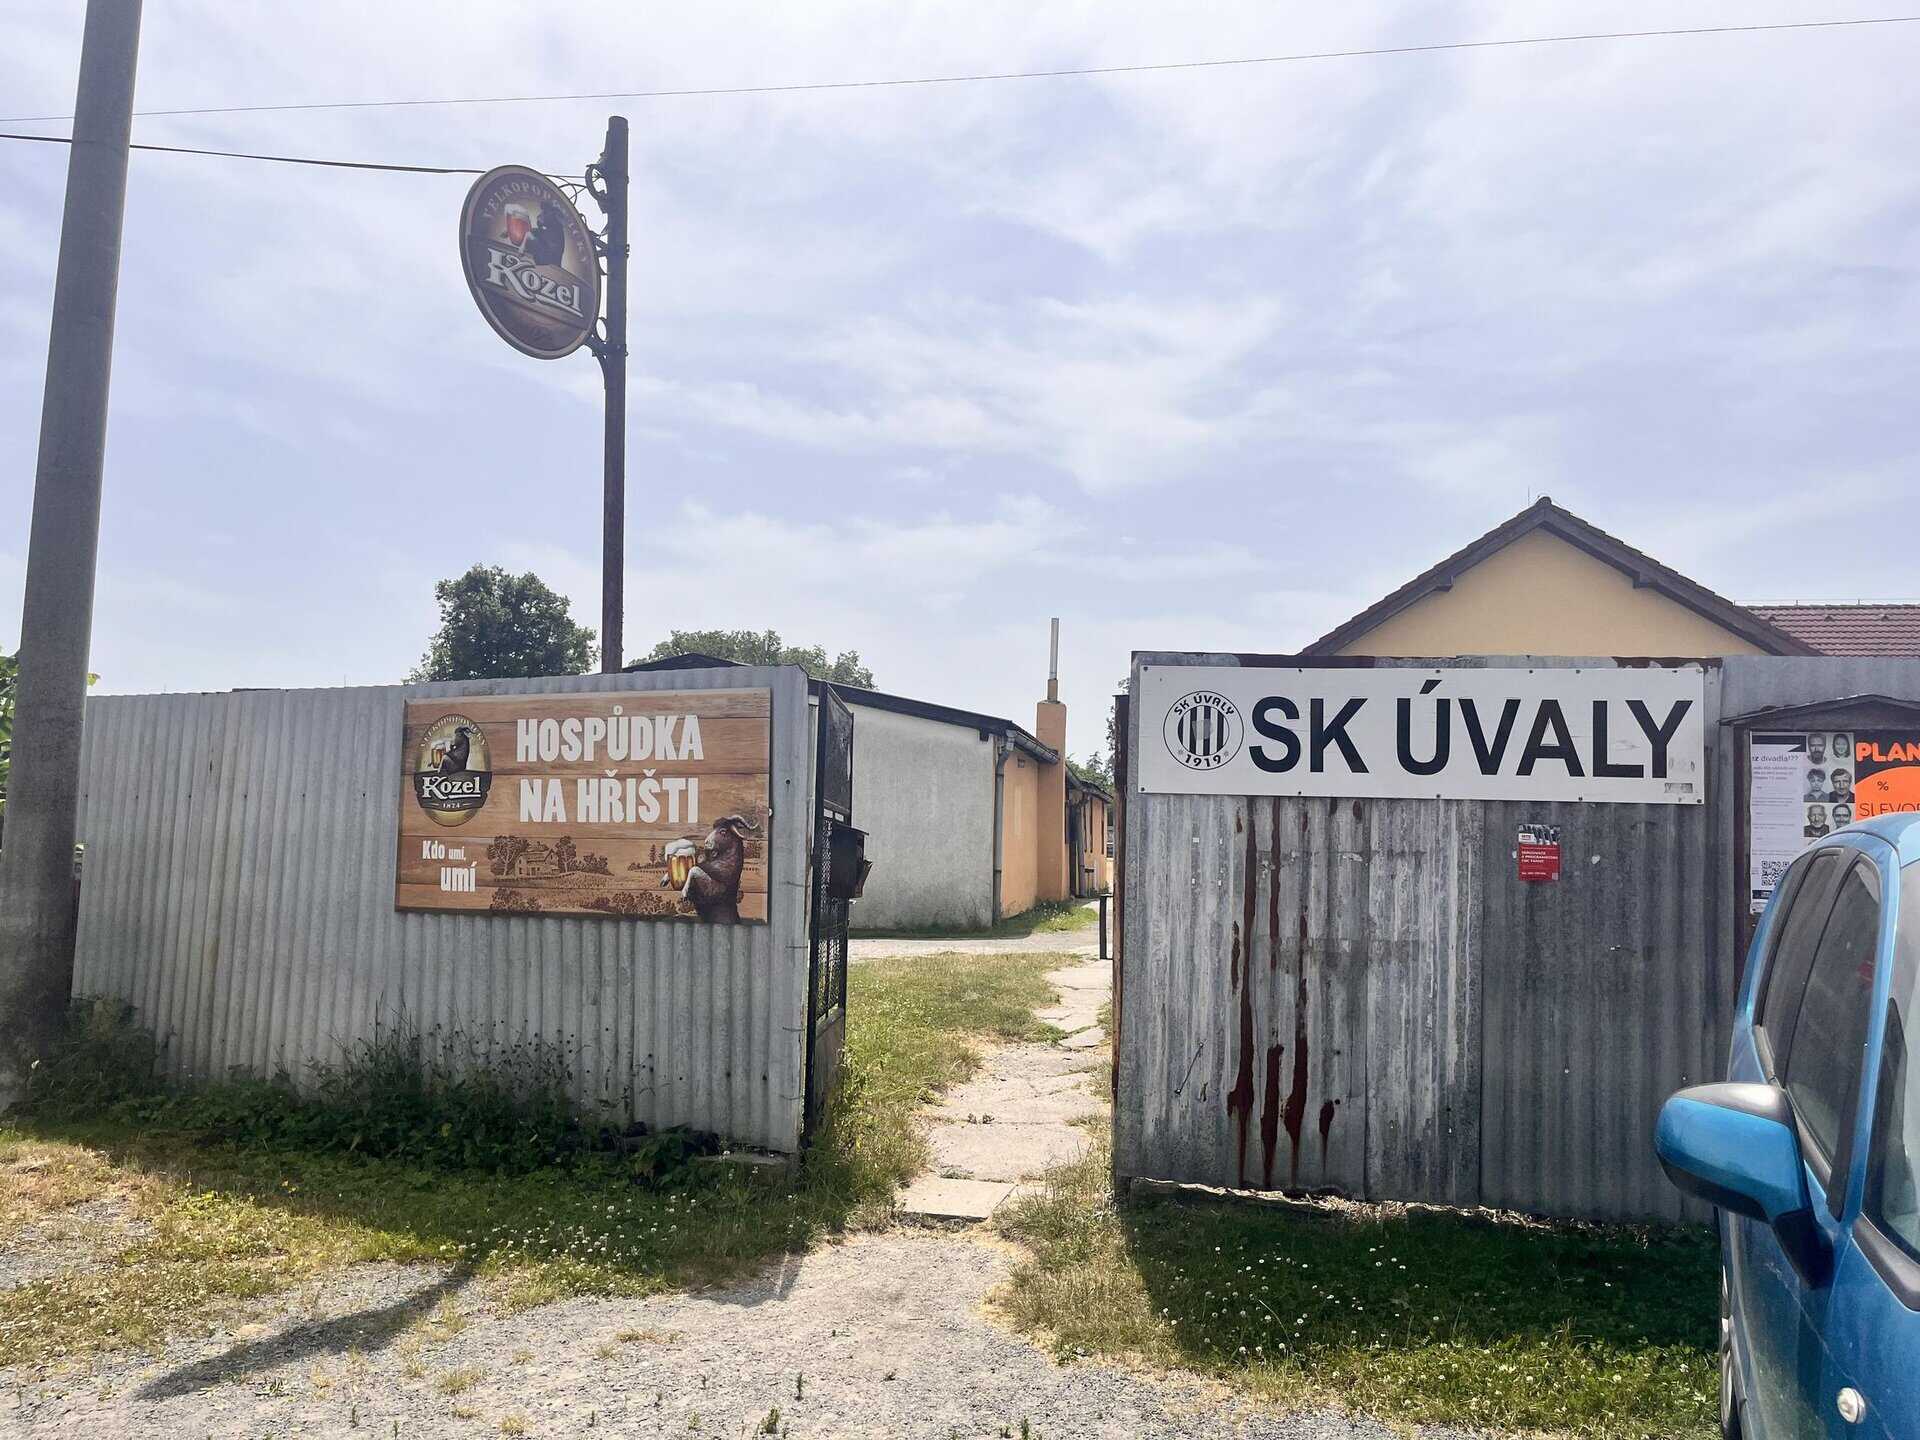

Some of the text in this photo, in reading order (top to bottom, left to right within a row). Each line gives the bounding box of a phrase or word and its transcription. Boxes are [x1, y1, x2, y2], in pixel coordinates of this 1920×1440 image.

[486, 247, 583, 317] Kozel
[1174, 693, 1235, 715] SK ÚVALY
[516, 705, 704, 762] HOSPŮDKA
[1249, 679, 1693, 779] SK ÚVALY
[1185, 754, 1222, 768] 1919
[1855, 742, 1920, 762] PLAN
[421, 776, 482, 800] Kozel
[519, 769, 699, 823] NA HŘIŠTI
[1859, 803, 1920, 817] SLEVO
[422, 840, 446, 860] Kdo
[440, 860, 478, 892] umí
